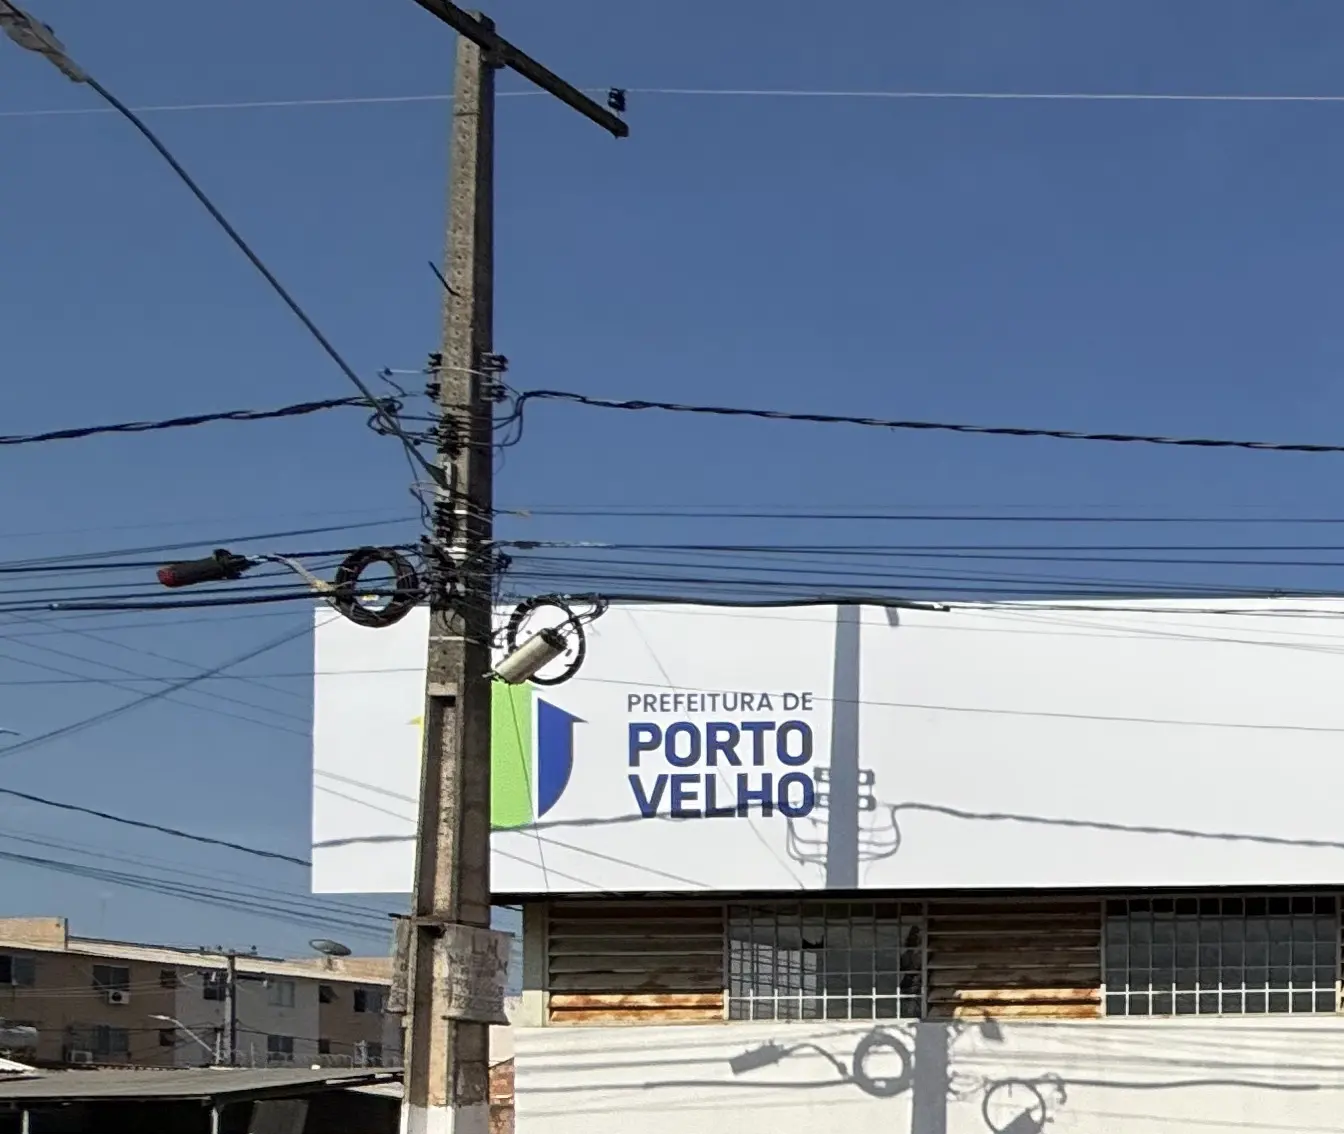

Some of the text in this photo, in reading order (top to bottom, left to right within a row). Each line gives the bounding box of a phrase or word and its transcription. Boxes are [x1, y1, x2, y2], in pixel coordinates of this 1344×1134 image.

[627, 692, 814, 713] PREFEITURA DE
[628, 719, 814, 768] PORTO
[628, 771, 816, 819] VELHO
